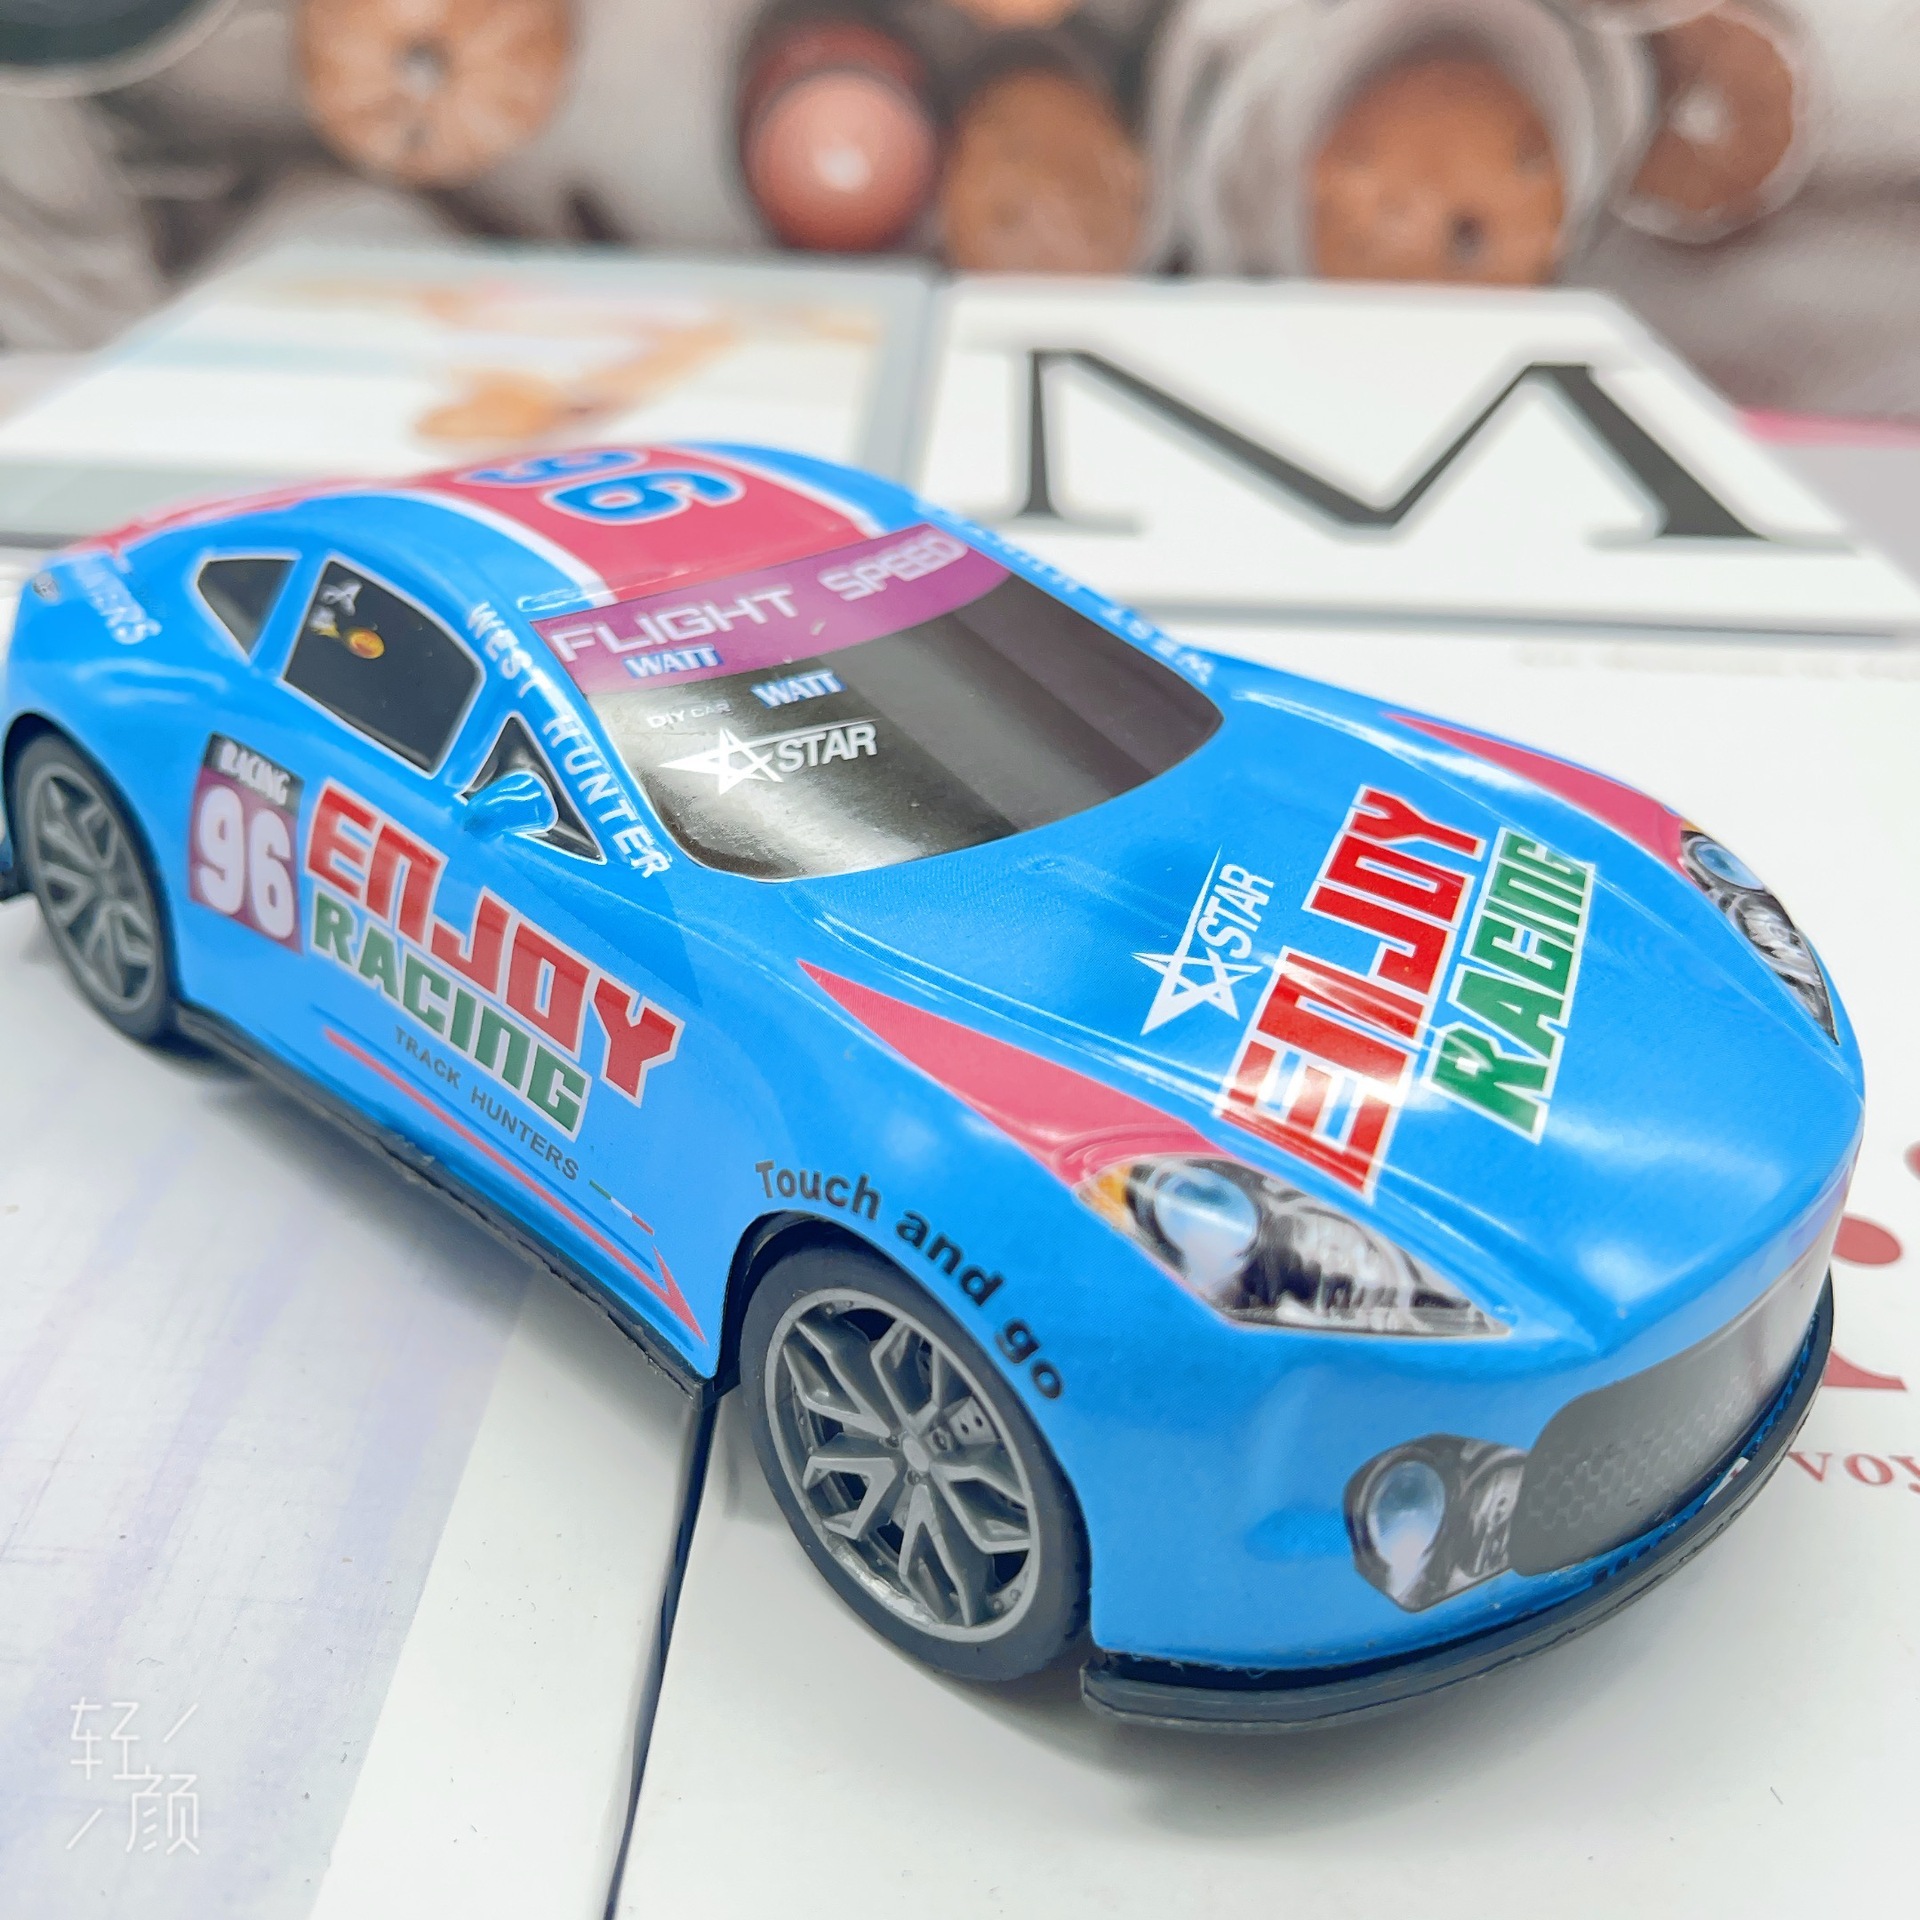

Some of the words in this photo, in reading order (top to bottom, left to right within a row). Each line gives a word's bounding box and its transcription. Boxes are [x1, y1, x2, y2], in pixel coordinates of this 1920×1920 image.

[970, 345, 1860, 548] M
[550, 581, 800, 662] FLIGHT
[817, 527, 970, 602] SPEED
[625, 645, 721, 679] WATT
[467, 601, 553, 699] WEST
[542, 712, 672, 878] HUNTER
[647, 710, 687, 730] DIY
[751, 669, 843, 707] WATT
[773, 722, 878, 774] STAR
[198, 783, 296, 941] 96
[1197, 860, 1275, 961] STAR
[304, 776, 686, 1108] ENJOY
[310, 883, 594, 1144] RACING
[1211, 783, 1488, 1207] ENJOY
[1418, 824, 1598, 1147] RACING
[394, 1024, 463, 1091] TRACK
[470, 1084, 581, 1182] HUNTERS
[754, 1159, 883, 1222] Touch
[895, 1210, 1005, 1308] and
[996, 1316, 1065, 1400] go
